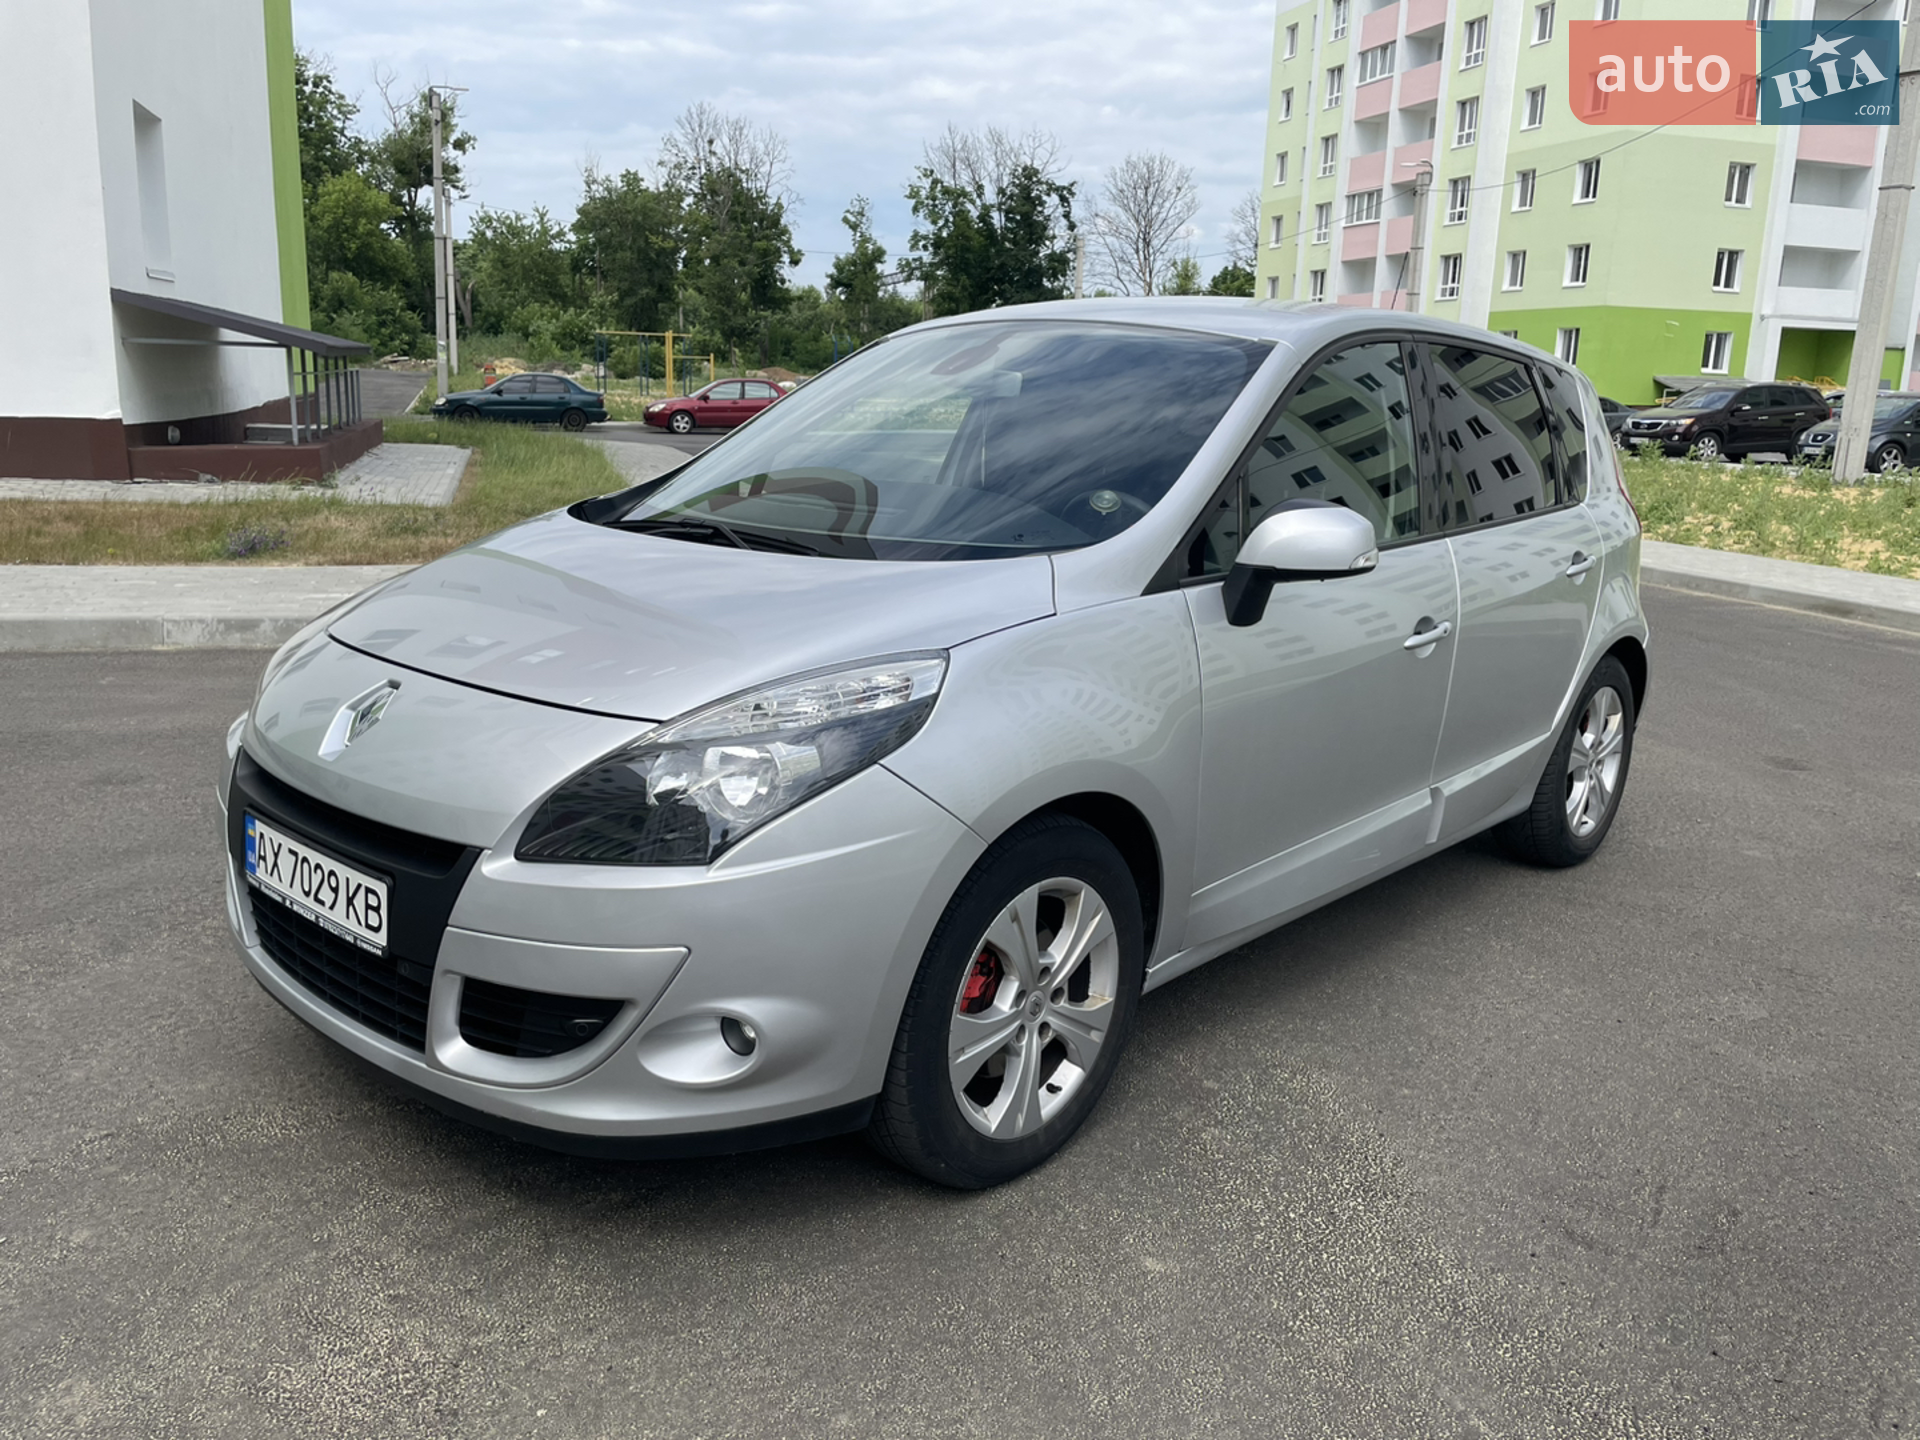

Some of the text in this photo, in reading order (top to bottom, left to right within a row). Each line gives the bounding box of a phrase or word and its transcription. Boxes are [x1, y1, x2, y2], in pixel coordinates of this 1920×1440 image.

[257, 831, 283, 884] AX
[288, 847, 340, 911] 7029
[345, 874, 383, 934] KB
